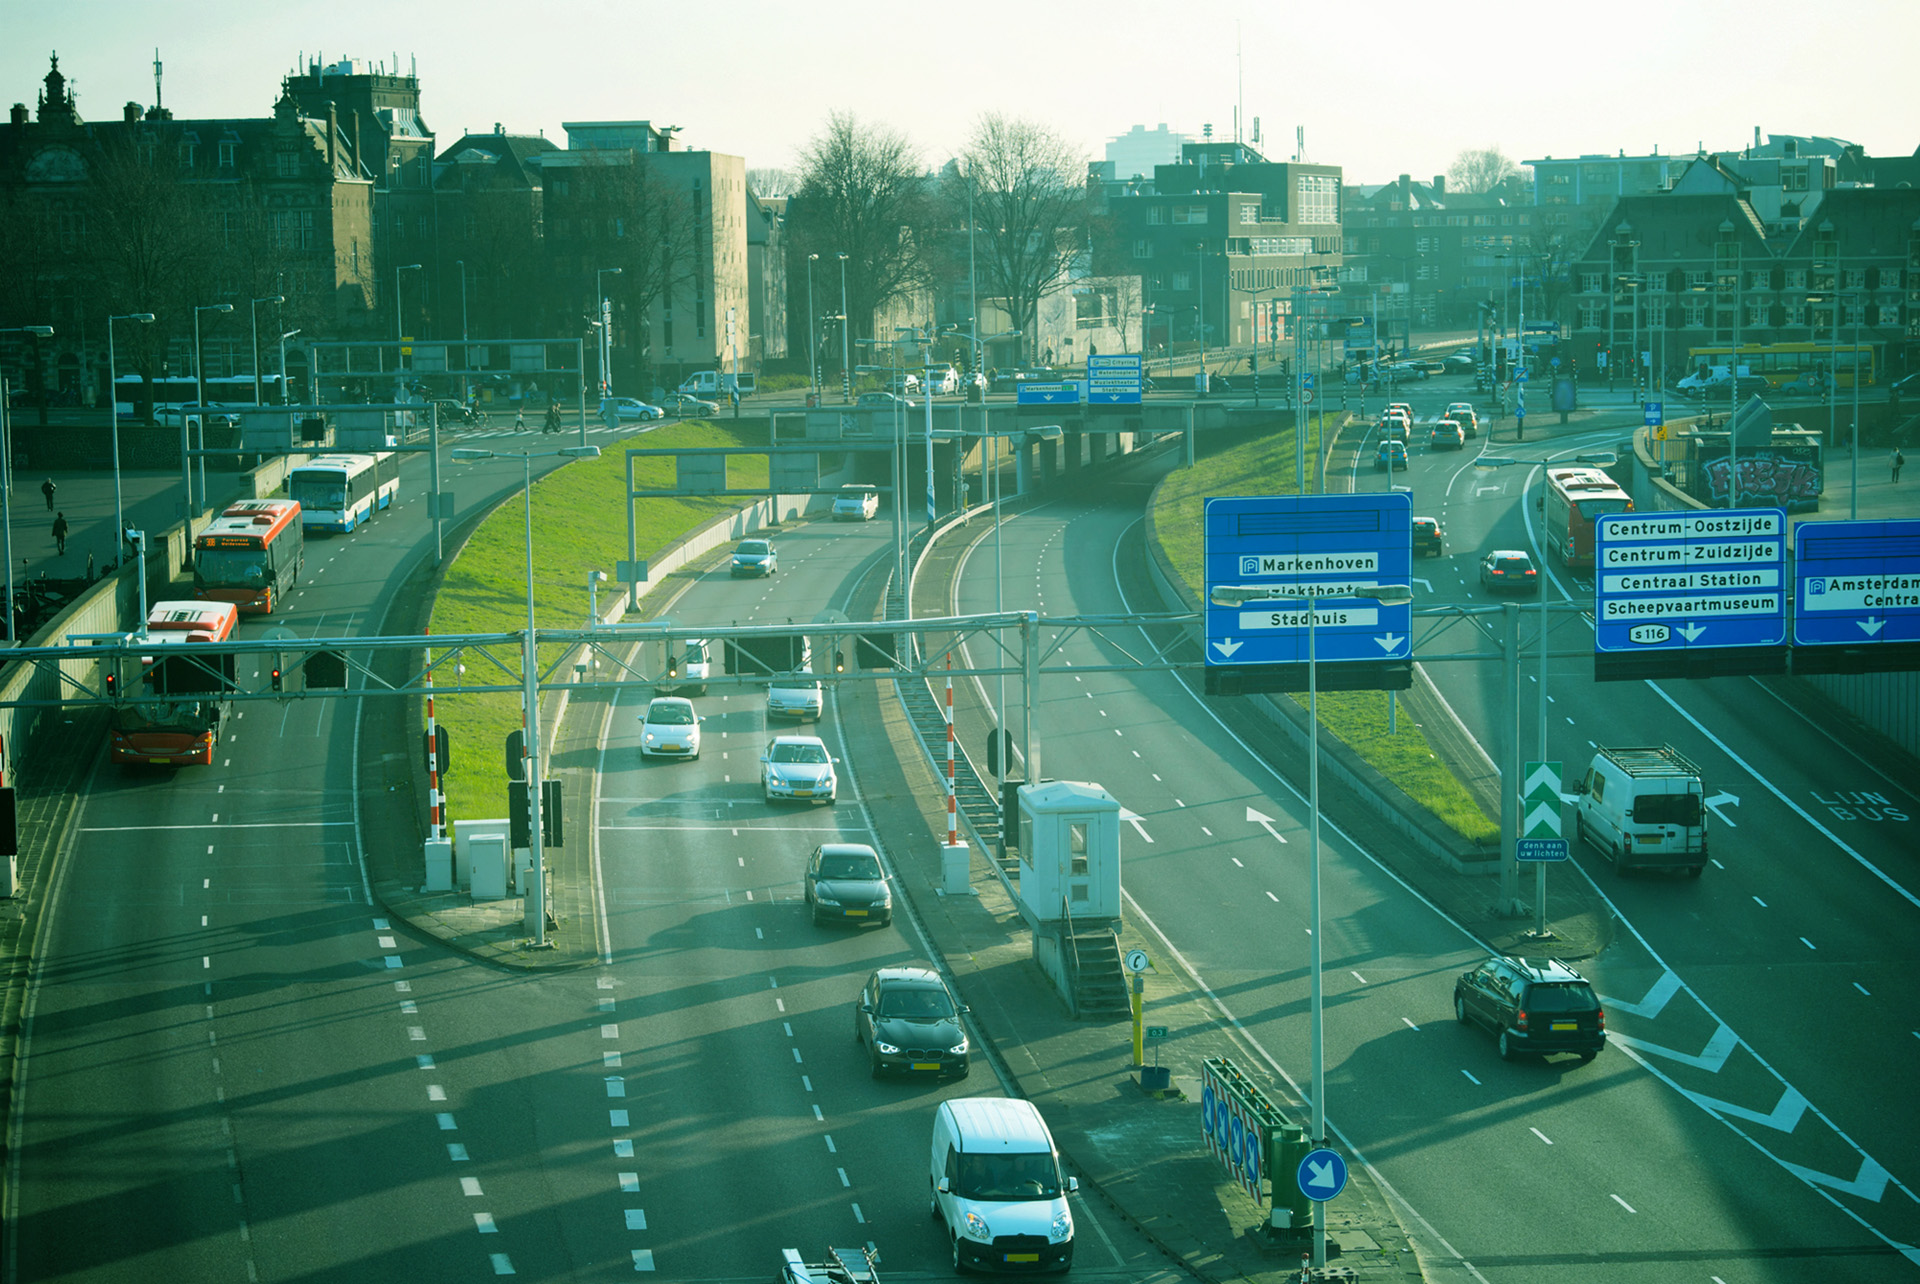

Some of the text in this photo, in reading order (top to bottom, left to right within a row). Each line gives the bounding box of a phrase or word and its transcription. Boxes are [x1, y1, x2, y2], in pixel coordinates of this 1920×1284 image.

[1609, 518, 1772, 535] Centrum-Oostzijde
[1608, 545, 1773, 562] Centrum-Zuidzijde
[1263, 556, 1374, 572] Markenhoven
[1621, 572, 1762, 589] Centraal Station
[1608, 598, 1775, 615] Scheepvaartmuseum
[1809, 791, 1892, 805] LIJN
[1827, 806, 1910, 821] BUS
[1534, 849, 1565, 857] lichten
